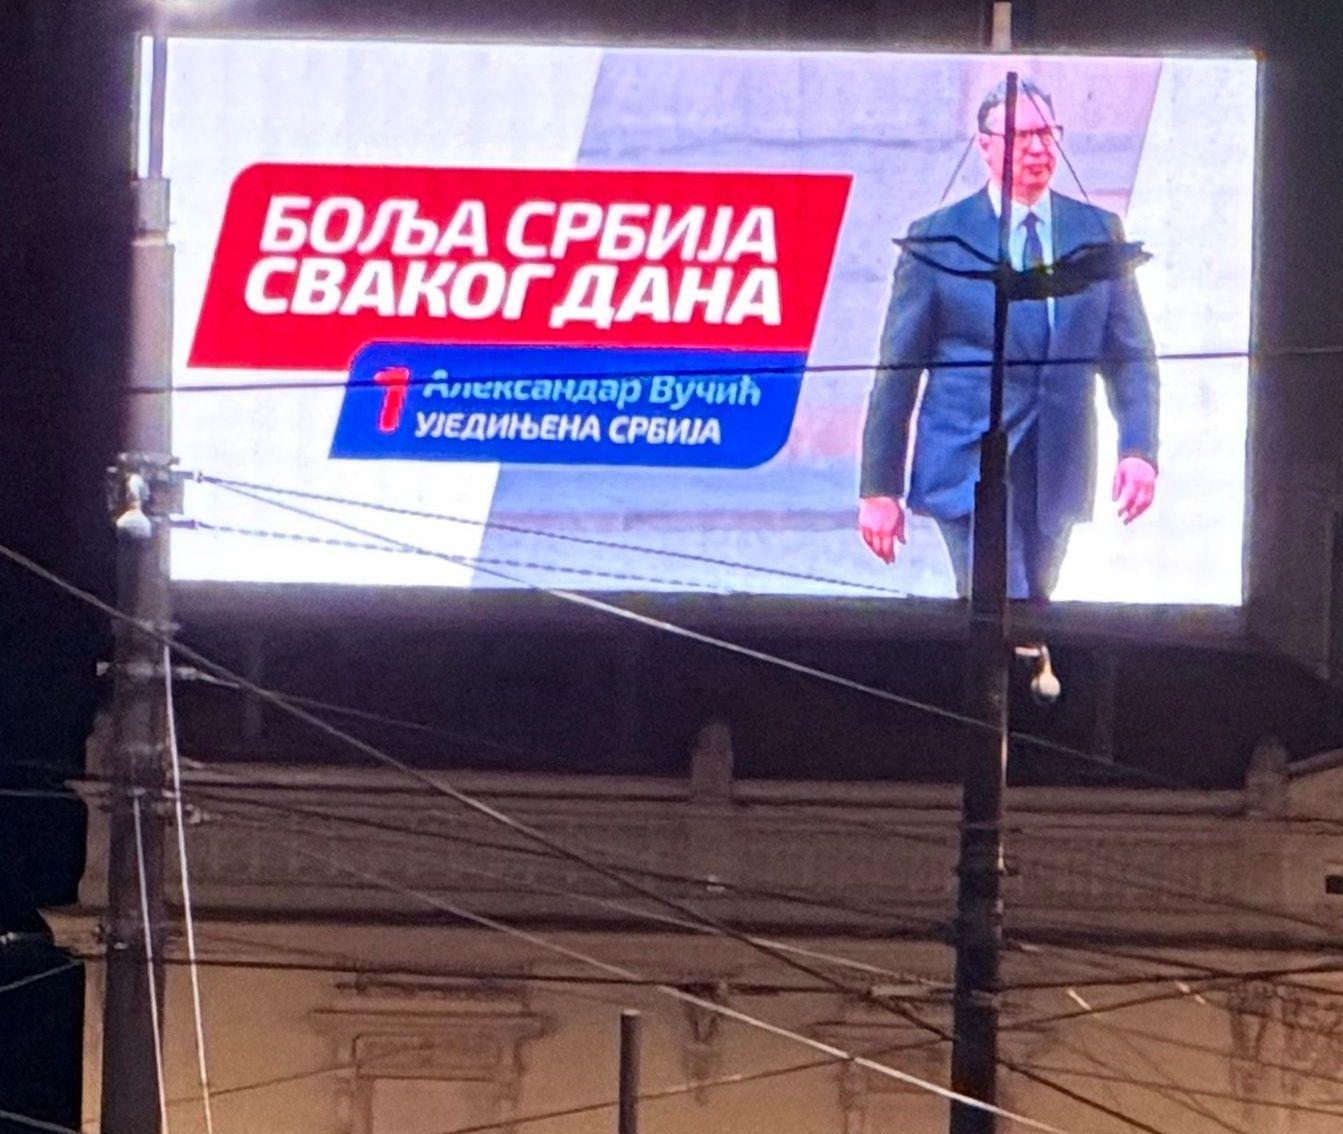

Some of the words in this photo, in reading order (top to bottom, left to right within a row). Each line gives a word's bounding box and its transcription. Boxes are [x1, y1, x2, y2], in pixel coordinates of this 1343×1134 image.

[258, 195, 489, 257] БОЉА
[505, 199, 779, 264] СРБИЈА
[243, 255, 555, 321] СВАКОГ
[548, 263, 782, 329] ДАНА
[373, 366, 411, 433] 1
[421, 368, 642, 411] Александар
[649, 373, 762, 411] Вучић
[413, 410, 602, 442] УЈЕДИЊЕНА
[607, 414, 723, 446] СРБИЈА
